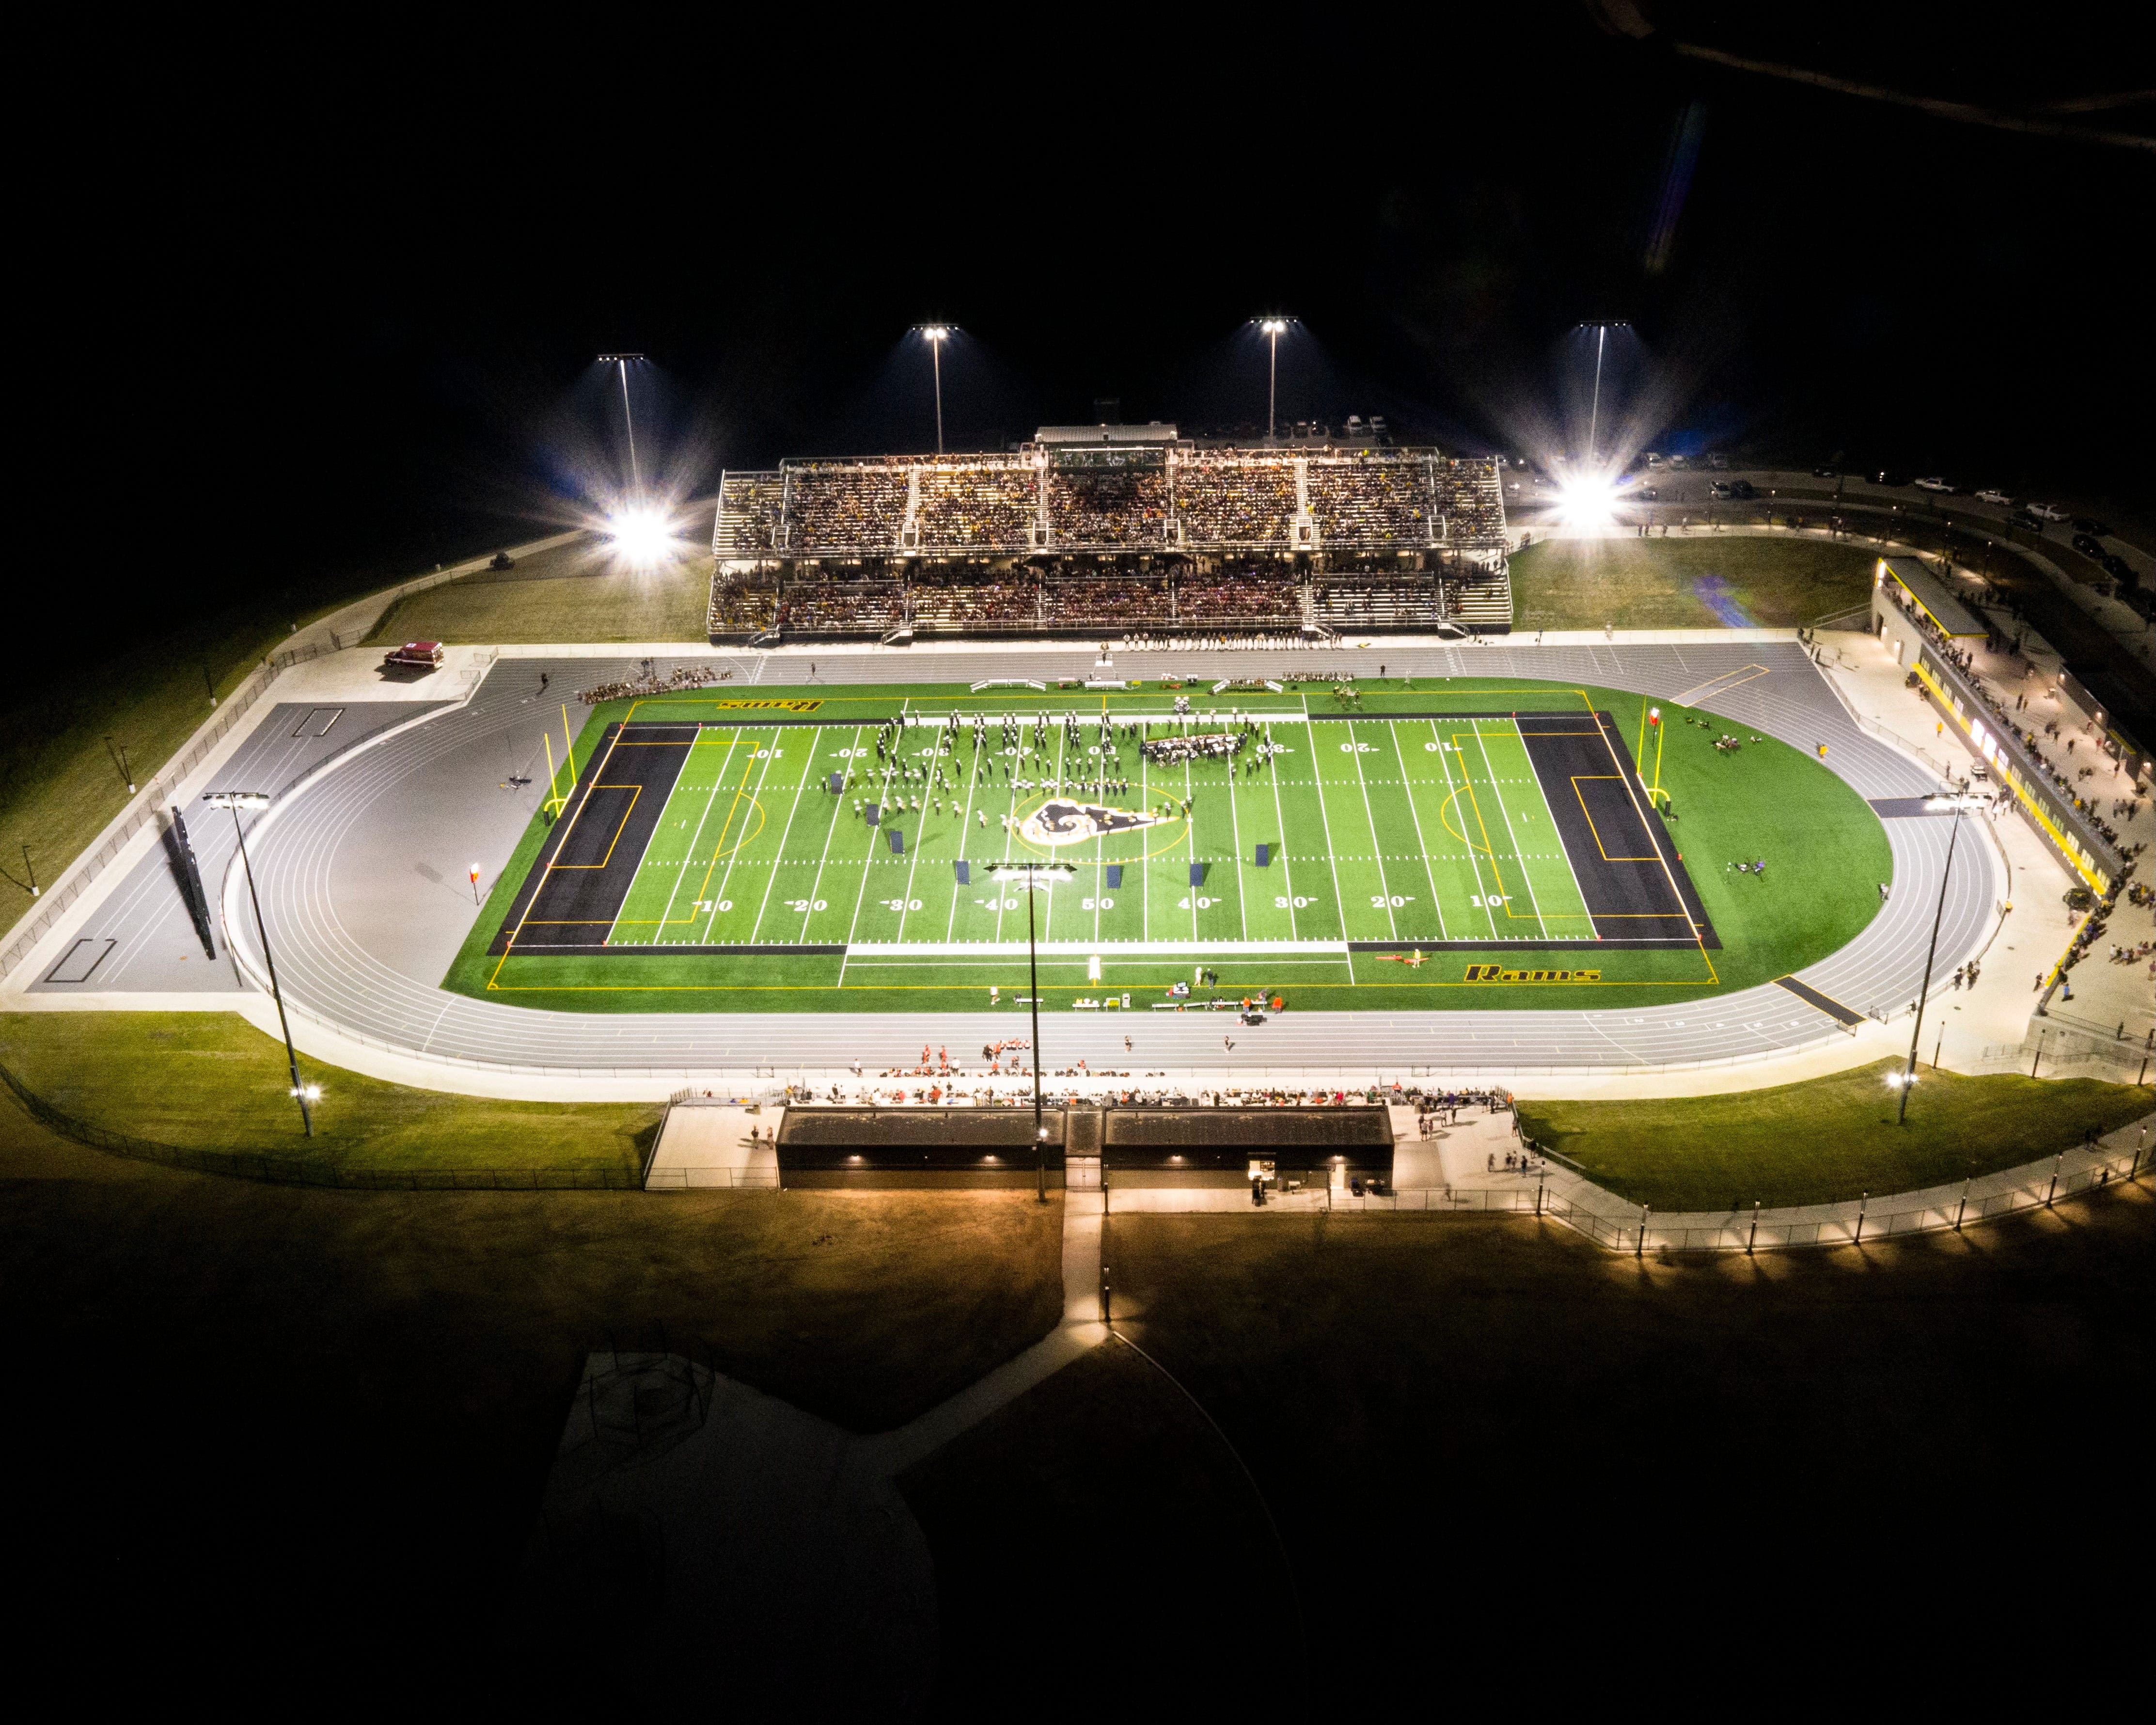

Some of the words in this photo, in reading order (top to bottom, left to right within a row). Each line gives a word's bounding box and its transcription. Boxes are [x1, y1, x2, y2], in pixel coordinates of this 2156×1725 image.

[716, 700, 824, 712] Rams
[838, 748, 868, 758] 20
[1340, 743, 1370, 753] 20
[1424, 742, 1453, 752] 10
[756, 749, 784, 759] 10
[701, 900, 733, 912] 10
[793, 899, 828, 912] 20
[889, 899, 923, 911] 30
[984, 898, 1019, 911] 40
[1081, 898, 1114, 910] 50
[1178, 897, 1211, 909] 40
[1275, 896, 1308, 909] 30
[1370, 896, 1405, 908] 20
[1469, 895, 1503, 907] 10
[1464, 964, 1601, 982] Rams
